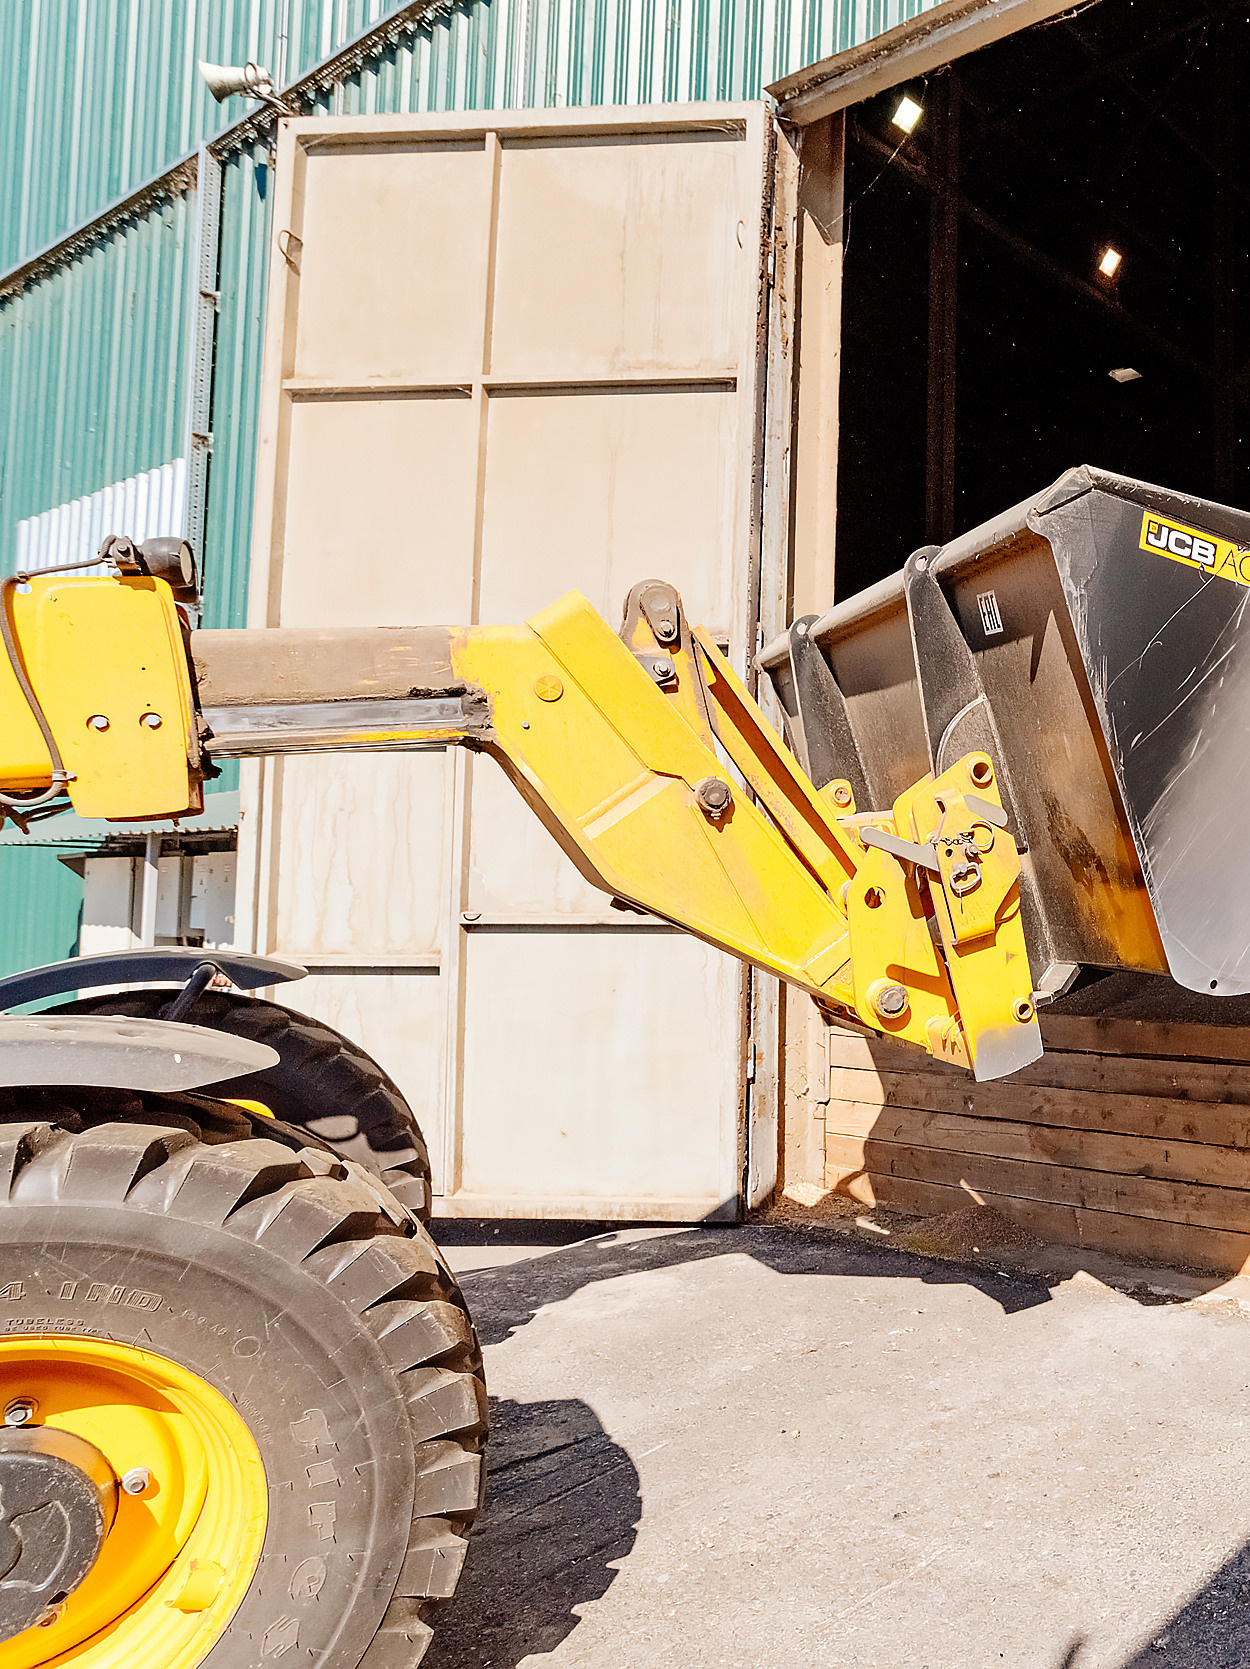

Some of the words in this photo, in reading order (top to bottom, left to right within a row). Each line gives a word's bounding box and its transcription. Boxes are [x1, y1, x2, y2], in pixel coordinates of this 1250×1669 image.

[1147, 525, 1215, 566] JCB
[59, 1281, 164, 1312] IND
[6, 1317, 85, 1327] TUBELESS
